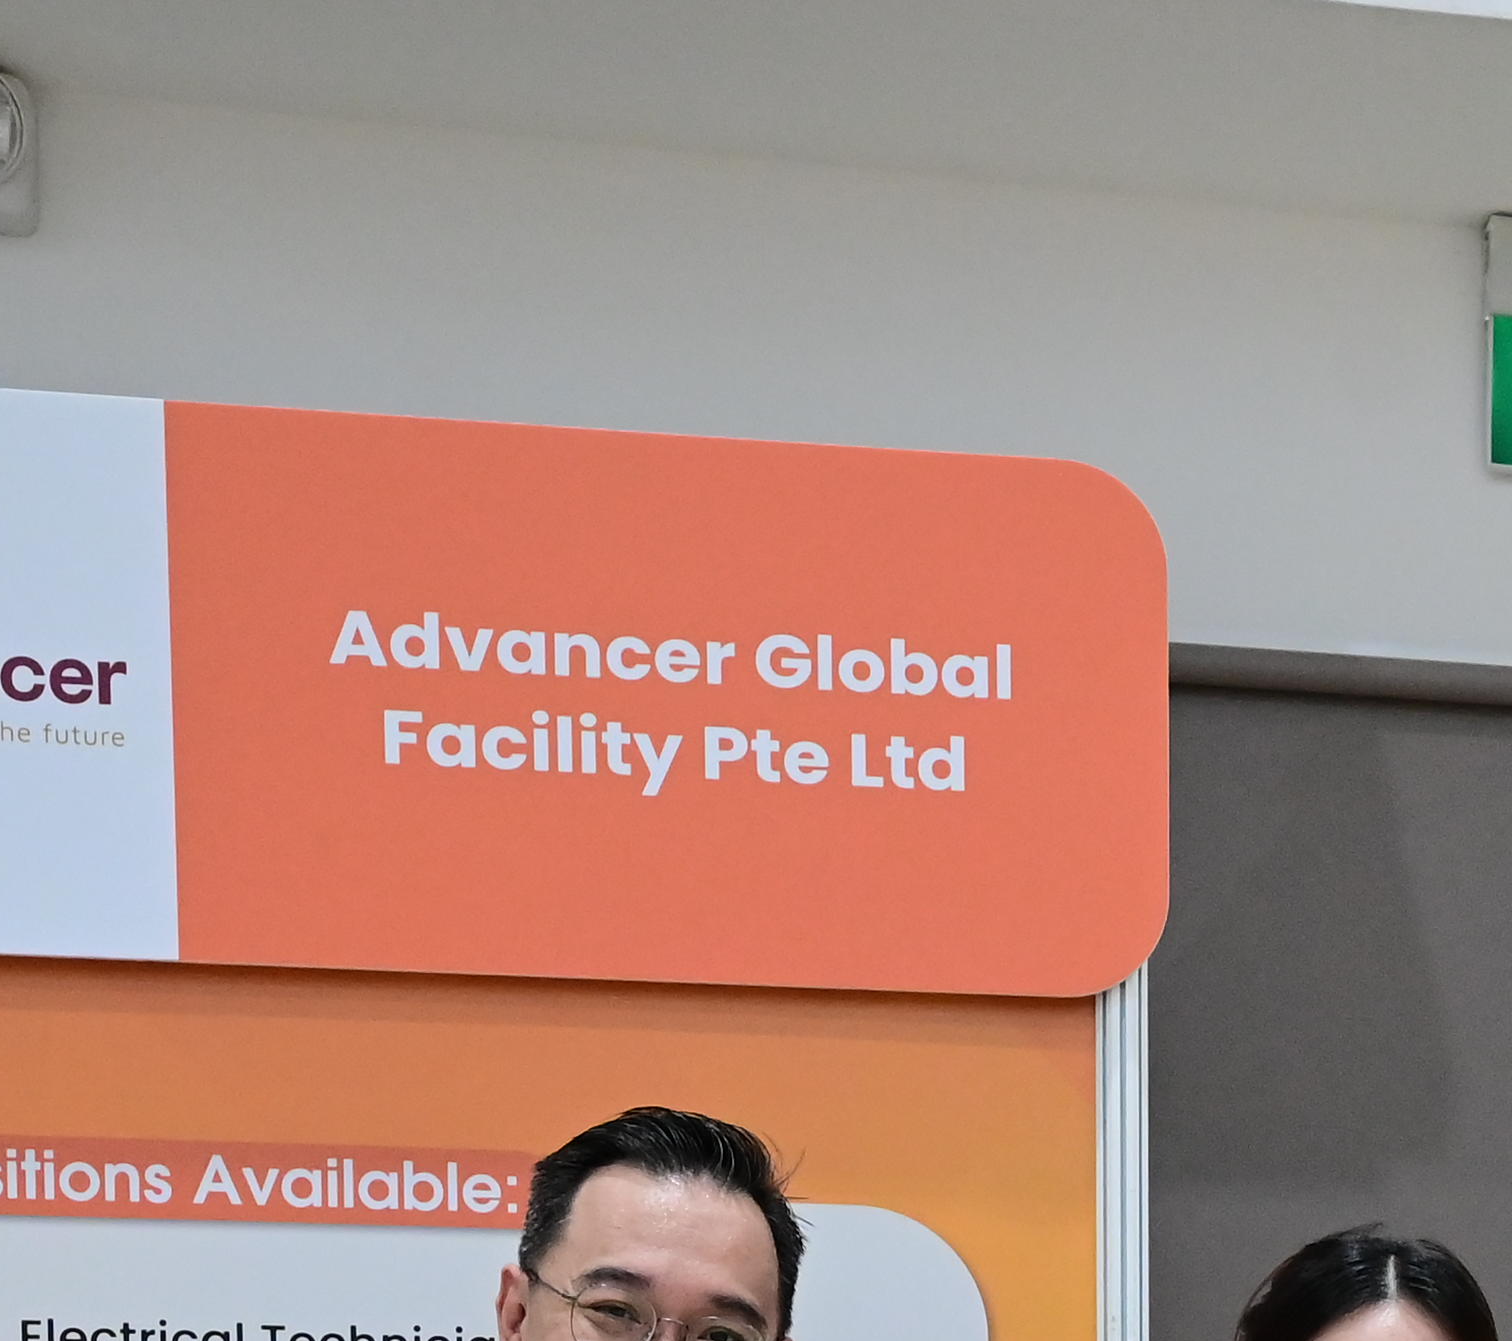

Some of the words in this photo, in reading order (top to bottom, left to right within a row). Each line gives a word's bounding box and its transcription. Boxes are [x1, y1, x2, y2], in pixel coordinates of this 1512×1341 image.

[329, 610, 735, 685] Advancer
[755, 634, 1012, 700] Global
[42, 722, 126, 747] future
[383, 709, 683, 797] Facility
[703, 725, 830, 785] Pte
[850, 733, 966, 792] Ltd
[193, 1152, 520, 1214] Available:
